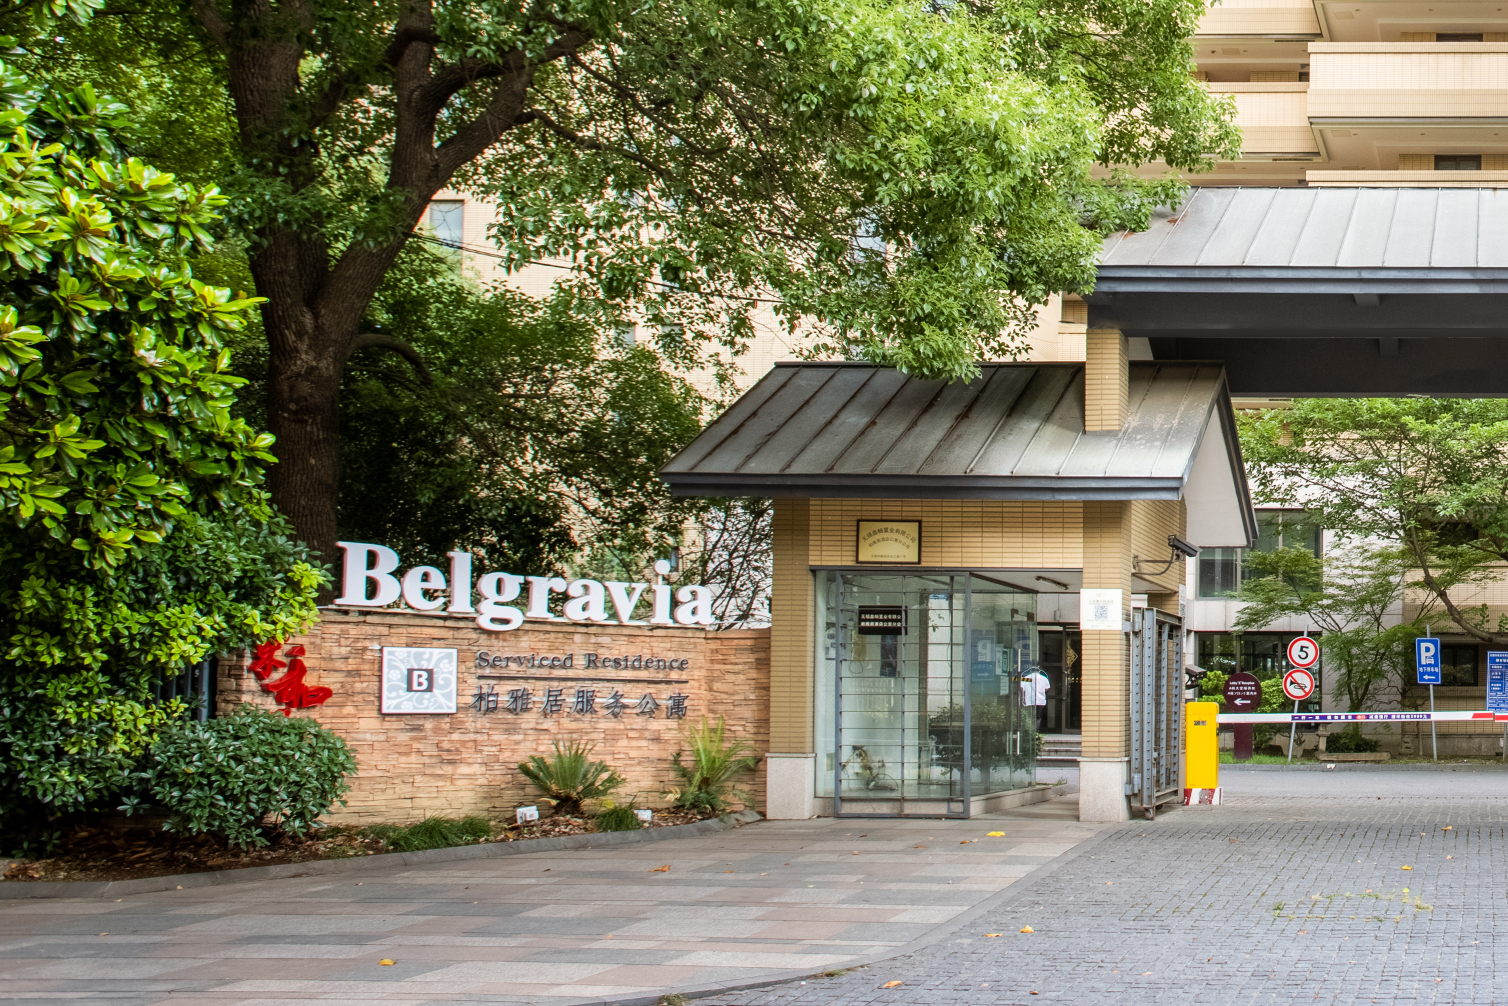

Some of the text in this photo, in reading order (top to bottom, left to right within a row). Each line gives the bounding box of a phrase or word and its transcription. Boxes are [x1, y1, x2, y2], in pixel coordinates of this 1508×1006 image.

[334, 540, 715, 631] Belgravia
[476, 650, 689, 671] Serviced Residence
[1297, 645, 1310, 660] 5
[1420, 642, 1436, 665] P
[411, 670, 429, 691] B
[469, 683, 690, 719] 柏雅居服务公寓
